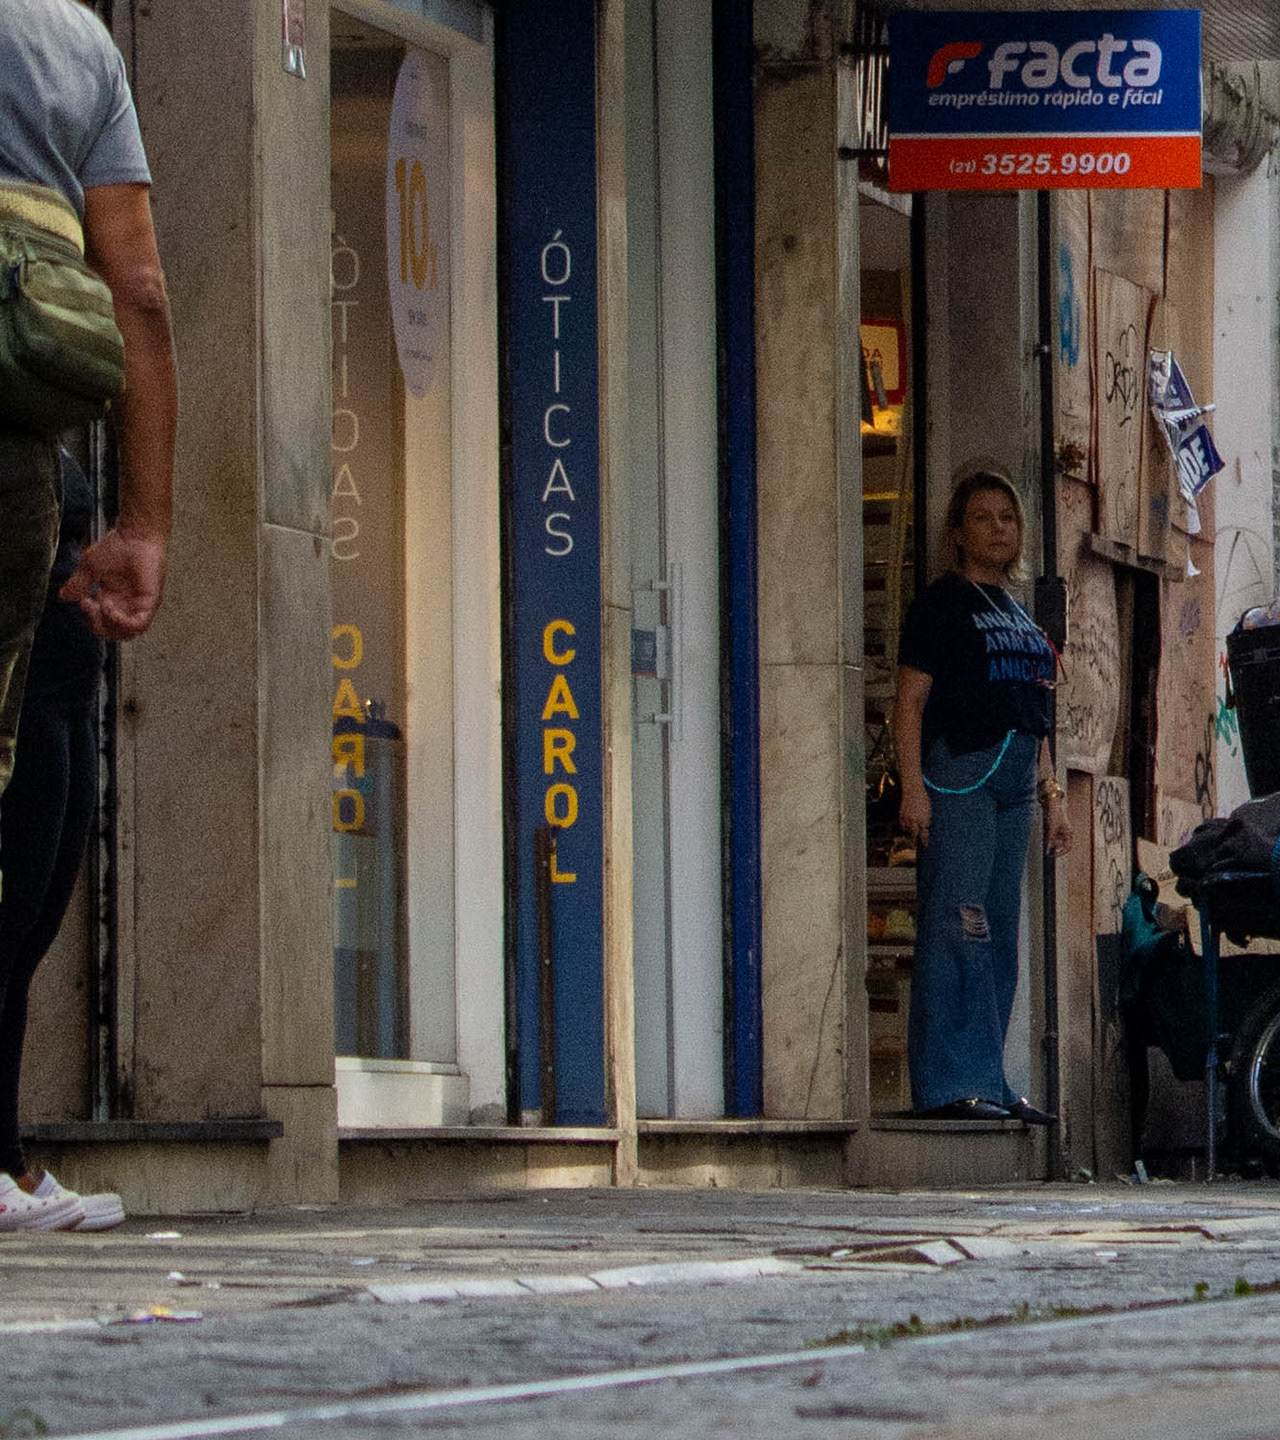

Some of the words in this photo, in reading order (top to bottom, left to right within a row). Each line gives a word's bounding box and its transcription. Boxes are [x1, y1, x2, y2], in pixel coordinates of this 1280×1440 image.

[987, 32, 1163, 89] facta
[928, 88, 1040, 111] empréstimo
[1043, 87, 1103, 111] rápido
[1108, 93, 1120, 105] e
[980, 152, 1131, 176] 3525.9900
[539, 228, 578, 560] ÓTICAS
[541, 619, 577, 885] CAROL
